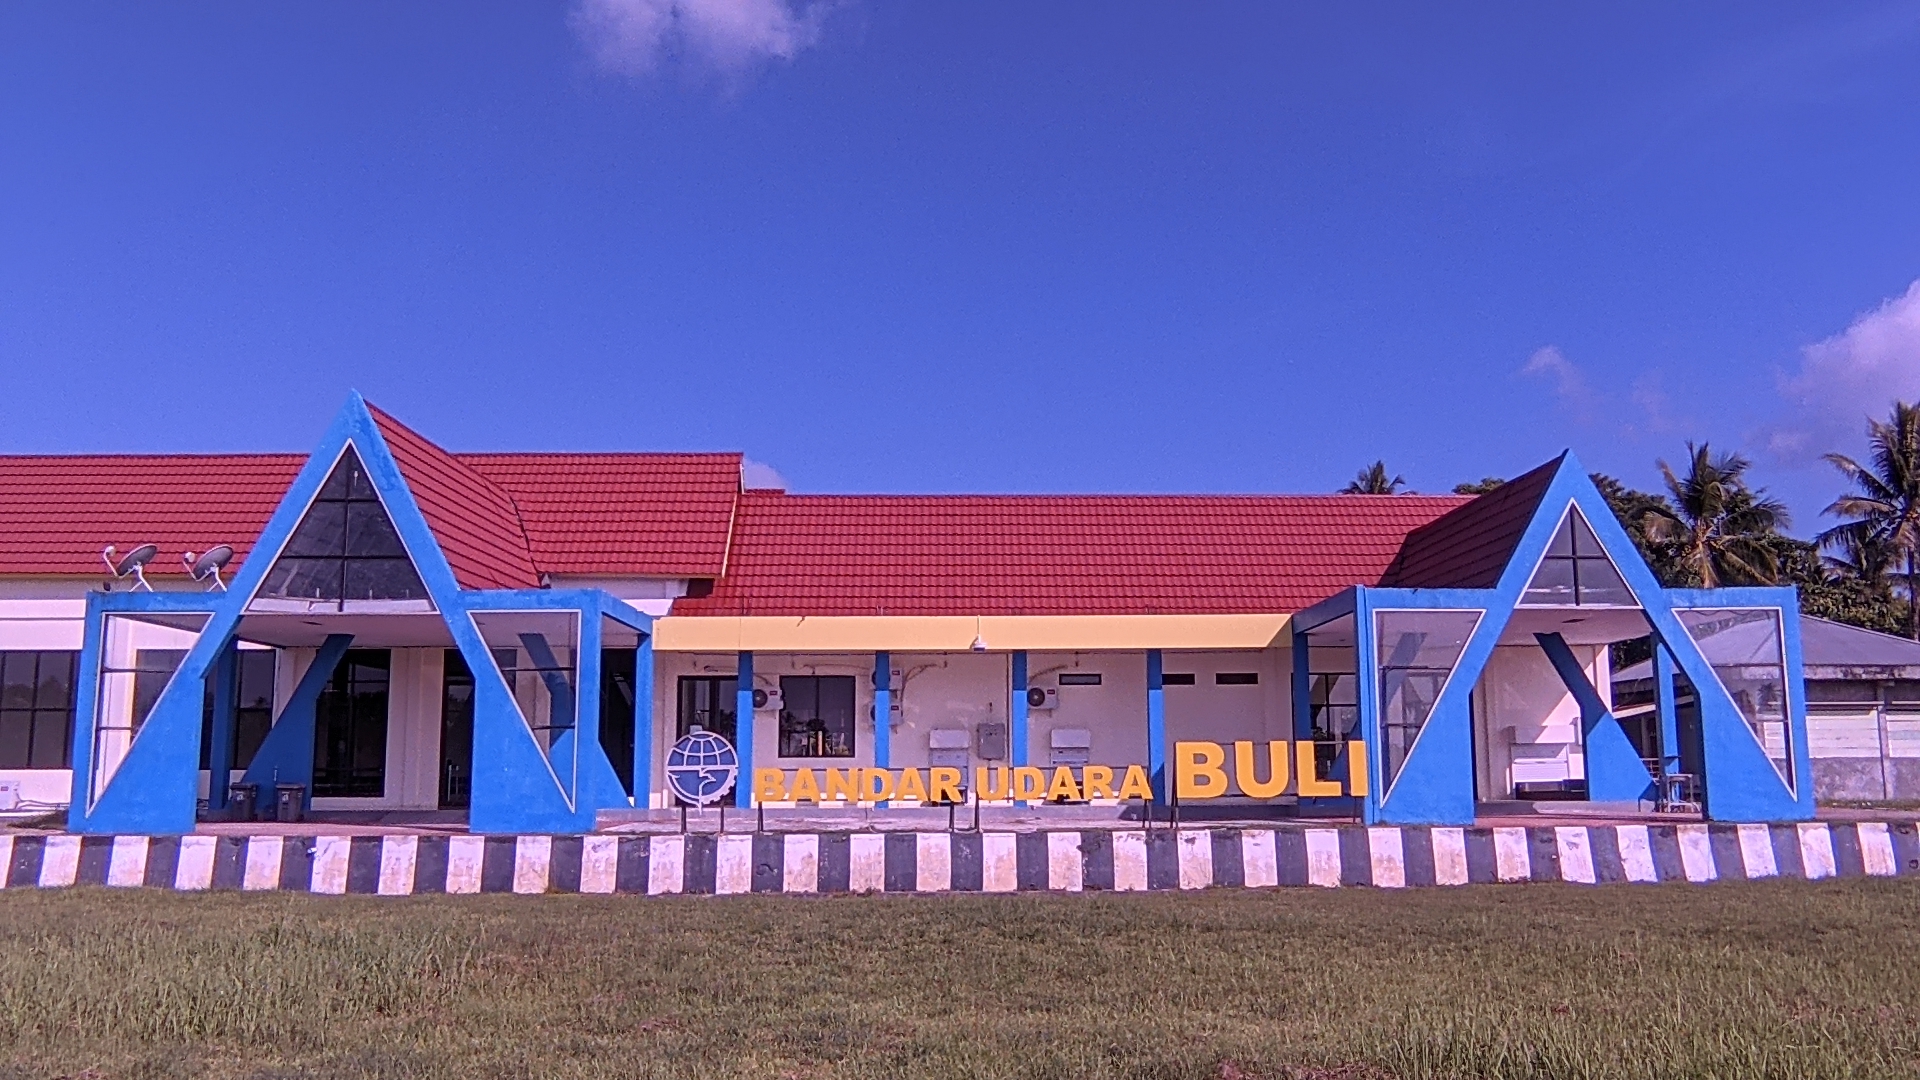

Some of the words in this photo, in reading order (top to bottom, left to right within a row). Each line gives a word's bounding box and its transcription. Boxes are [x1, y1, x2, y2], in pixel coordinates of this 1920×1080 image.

[754, 767, 962, 802] BANDAR
[976, 765, 1154, 801] UDARA
[1175, 741, 1368, 799] BULI
